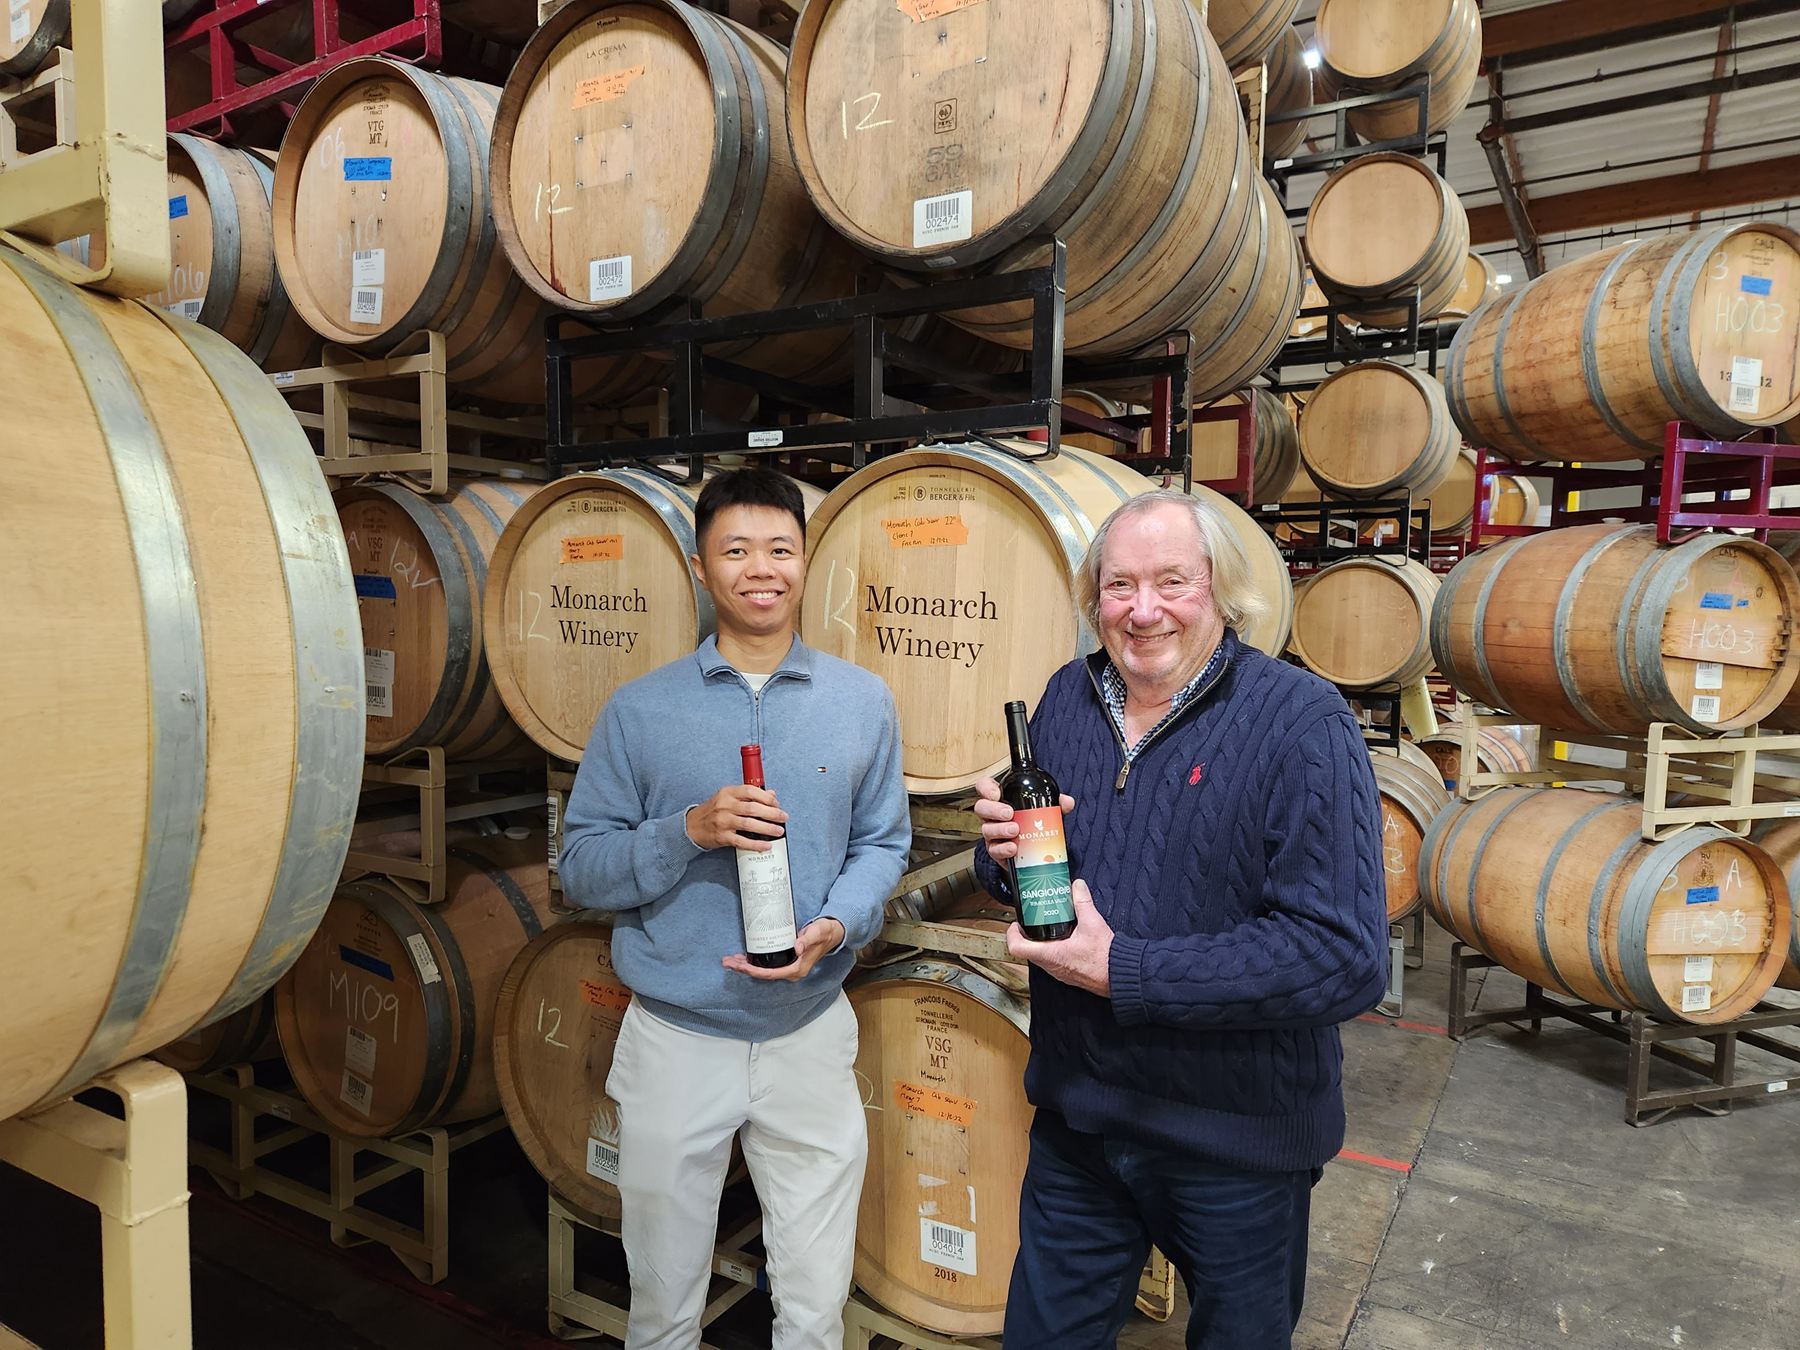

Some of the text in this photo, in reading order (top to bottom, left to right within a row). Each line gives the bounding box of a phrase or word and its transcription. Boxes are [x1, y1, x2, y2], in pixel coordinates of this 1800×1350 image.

[367, 120, 384, 132] VTG
[842, 91, 896, 140] 12
[369, 133, 382, 144] MT
[535, 182, 575, 223] 12
[925, 214, 959, 229] 002474
[1710, 252, 1728, 281] 3
[550, 585, 648, 613] Monarch
[864, 584, 999, 621] Monarch
[519, 589, 550, 641] 12
[559, 620, 639, 654] Winery
[874, 626, 985, 669] Winery
[1384, 813, 1399, 835] A
[1725, 858, 1742, 892] A
[329, 968, 399, 1044] M109
[920, 1009, 954, 1021] TONNELLERIE
[538, 998, 570, 1049] 12
[926, 1024, 948, 1034] FRANCE
[925, 1035, 953, 1054] VSG
[930, 1053, 949, 1069] MT
[932, 1239, 963, 1256] 004014
[934, 1266, 958, 1283] 2018
